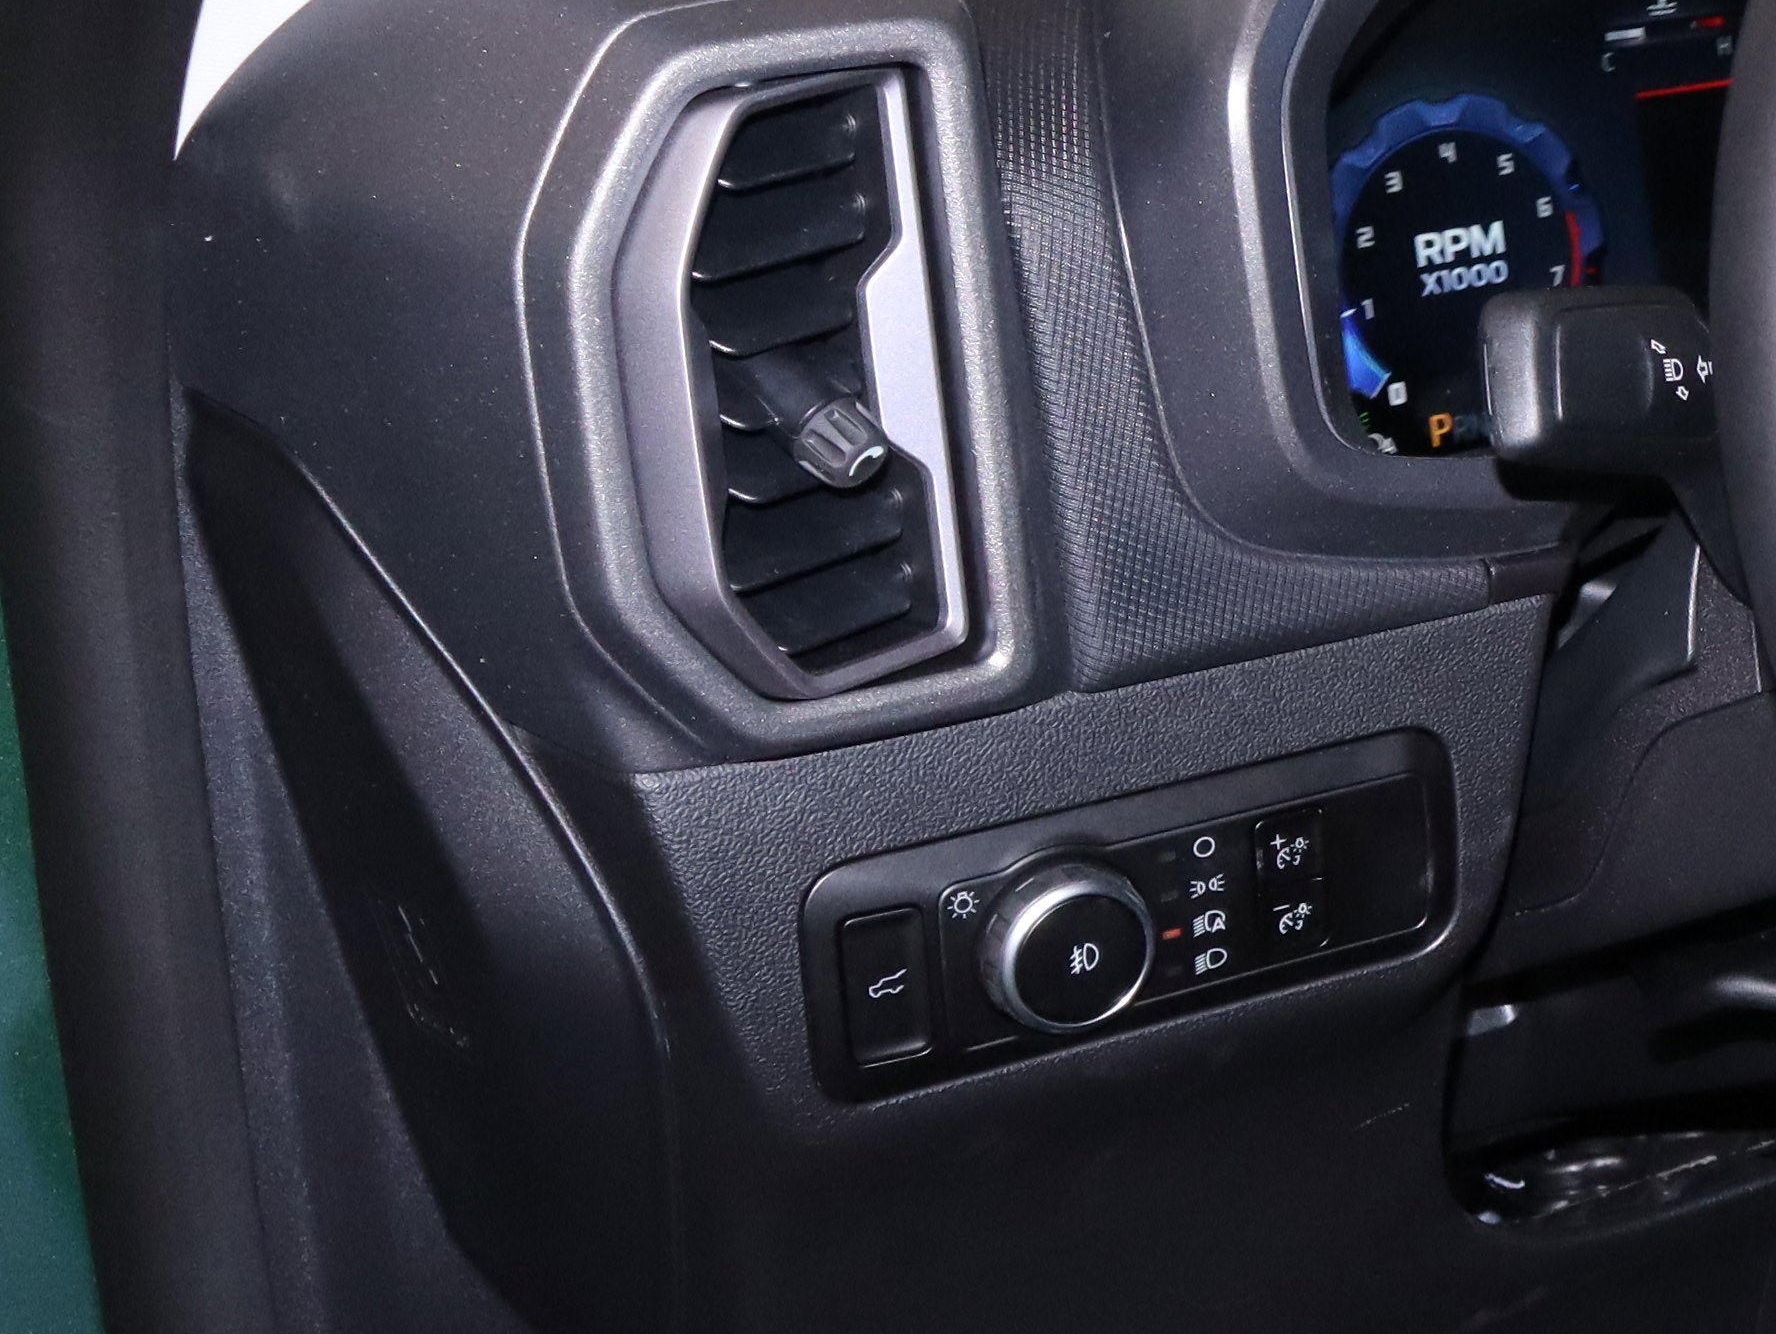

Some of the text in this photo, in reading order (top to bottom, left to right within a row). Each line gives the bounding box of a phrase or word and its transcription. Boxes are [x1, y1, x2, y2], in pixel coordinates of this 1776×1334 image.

[1438, 141, 1457, 164] 4
[1497, 153, 1515, 176] 5
[1385, 171, 1403, 194] 3
[1536, 196, 1553, 218] 6
[1356, 225, 1375, 249] 2
[1413, 220, 1507, 268] RPM
[1550, 265, 1565, 287] 7
[1360, 298, 1375, 320] 1
[1428, 412, 1454, 448] P
